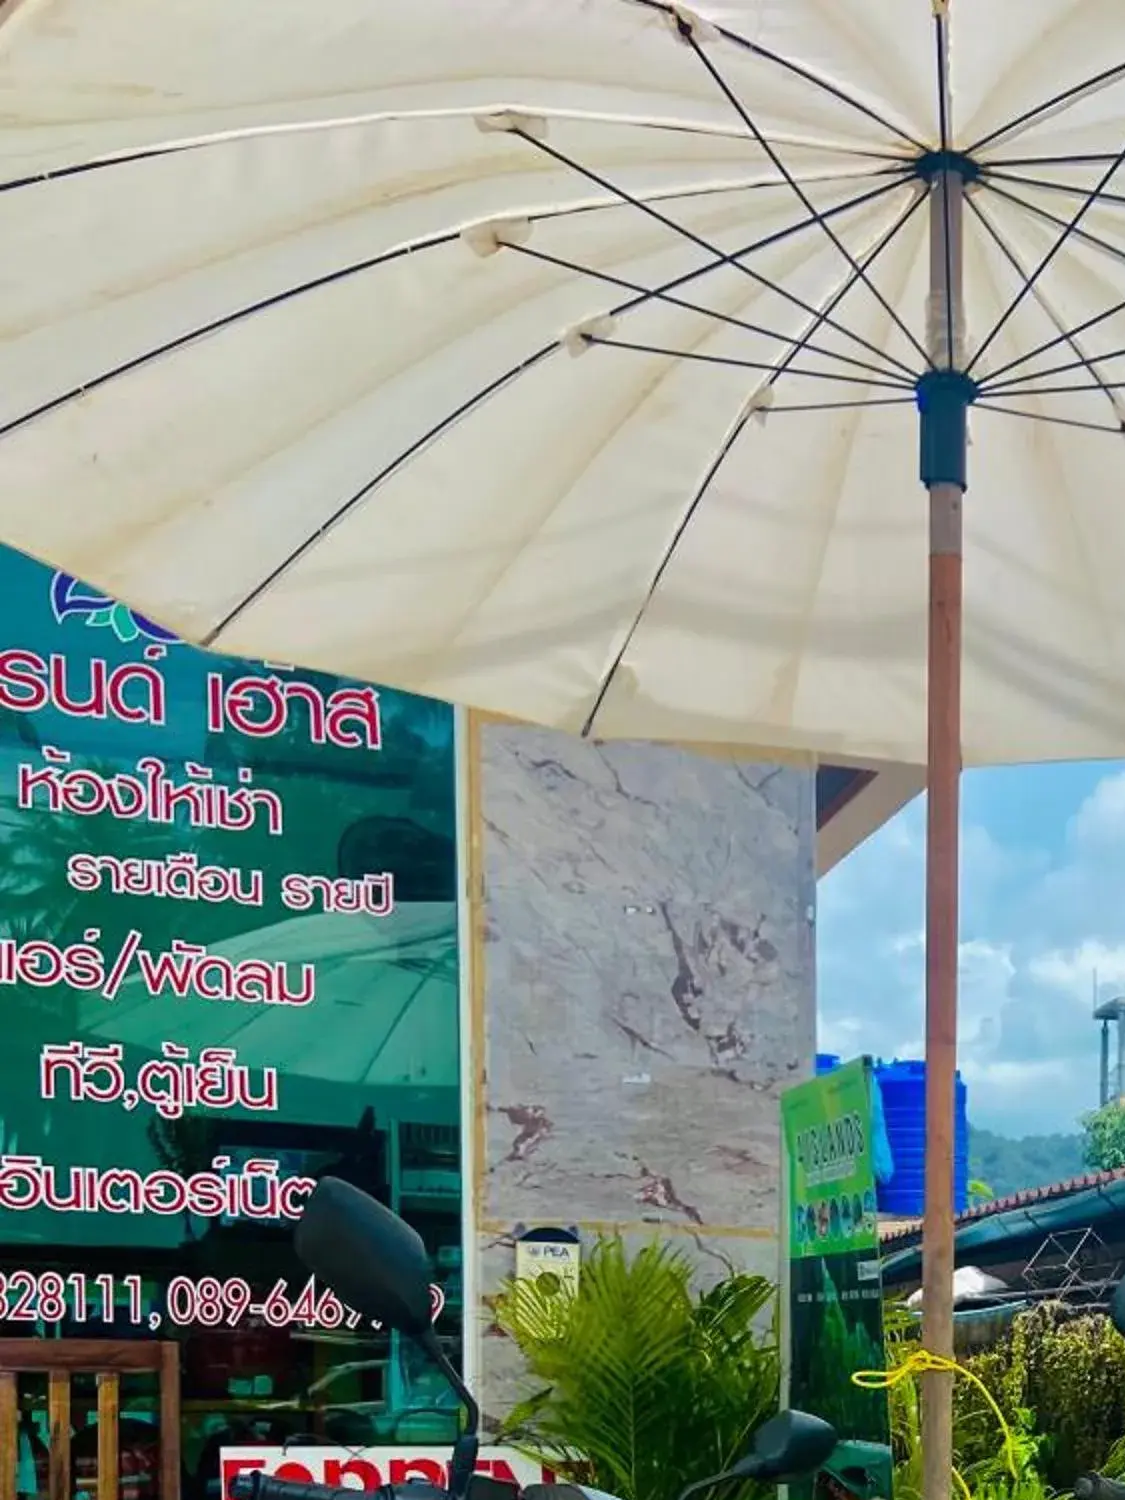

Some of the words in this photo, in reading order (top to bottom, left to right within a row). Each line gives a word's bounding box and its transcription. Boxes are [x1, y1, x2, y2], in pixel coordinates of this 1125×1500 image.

[17, 745, 283, 835] ห้องให้เช่า
[67, 851, 263, 906] รายเดือน
[281, 871, 394, 916] รายปี
[543, 1245, 570, 1258] PEA
